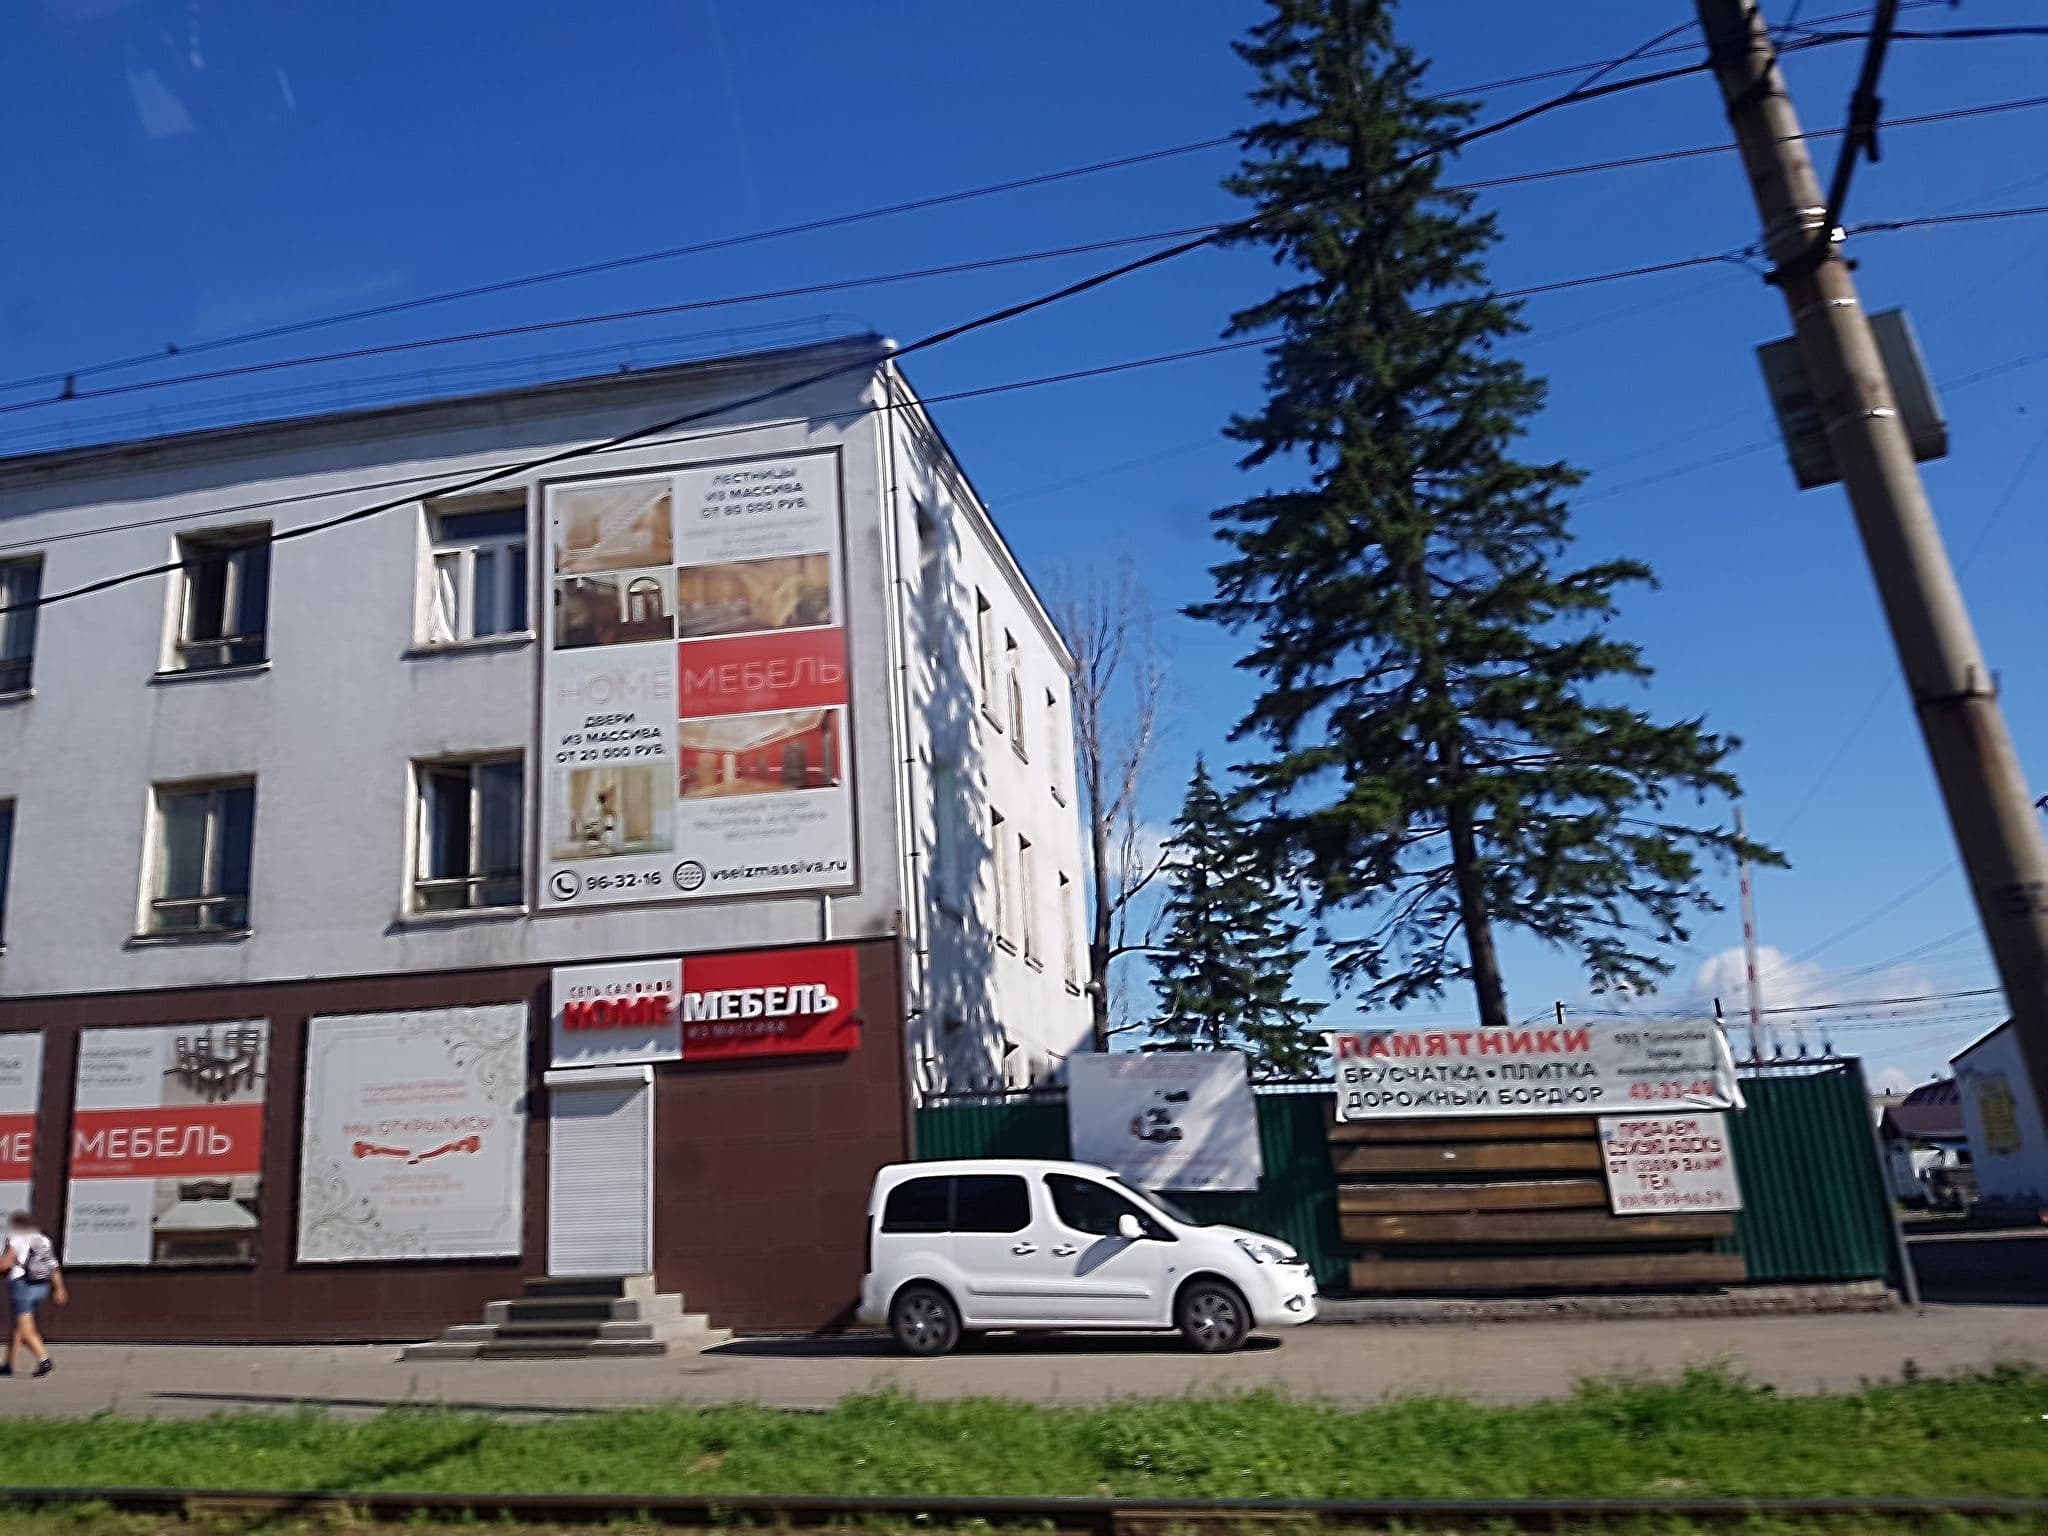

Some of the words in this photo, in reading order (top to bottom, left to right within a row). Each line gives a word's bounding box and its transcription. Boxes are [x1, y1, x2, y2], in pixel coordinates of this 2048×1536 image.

[712, 467, 798, 486] ЛЕСТНИЦЫ
[705, 490, 726, 502] ИЗ
[729, 482, 804, 498] МАССИВА
[702, 506, 720, 518] ОТ
[746, 500, 774, 513] 000
[557, 665, 671, 705] HOME
[684, 657, 843, 696] МЕБЕЛЬ
[584, 713, 635, 728] ДВЕРИ
[562, 734, 582, 745] ИЗ
[585, 727, 661, 743] МАССИВА
[556, 750, 576, 763] ОТ
[580, 749, 598, 761] 20
[601, 746, 631, 759] 000
[711, 859, 847, 880] vseizmassiva.ru
[586, 871, 662, 890] 96-32-16
[570, 986, 600, 998] СЕТЬ
[606, 980, 673, 996] САЛОНОВ
[563, 995, 673, 1031] HOME
[683, 984, 840, 1022] МЕБЕЛЬ
[1337, 1030, 1591, 1058] ПАМЯТНИКИ
[1343, 1065, 1479, 1084] БРУСЧАТКА
[1501, 1062, 1599, 1081] ПЛИТКА
[1347, 1088, 1491, 1109] ДОРОЖНЫЙ
[1498, 1086, 1604, 1105] БОРДЮР
[73, 1125, 234, 1160] МЕБЕЛЬ
